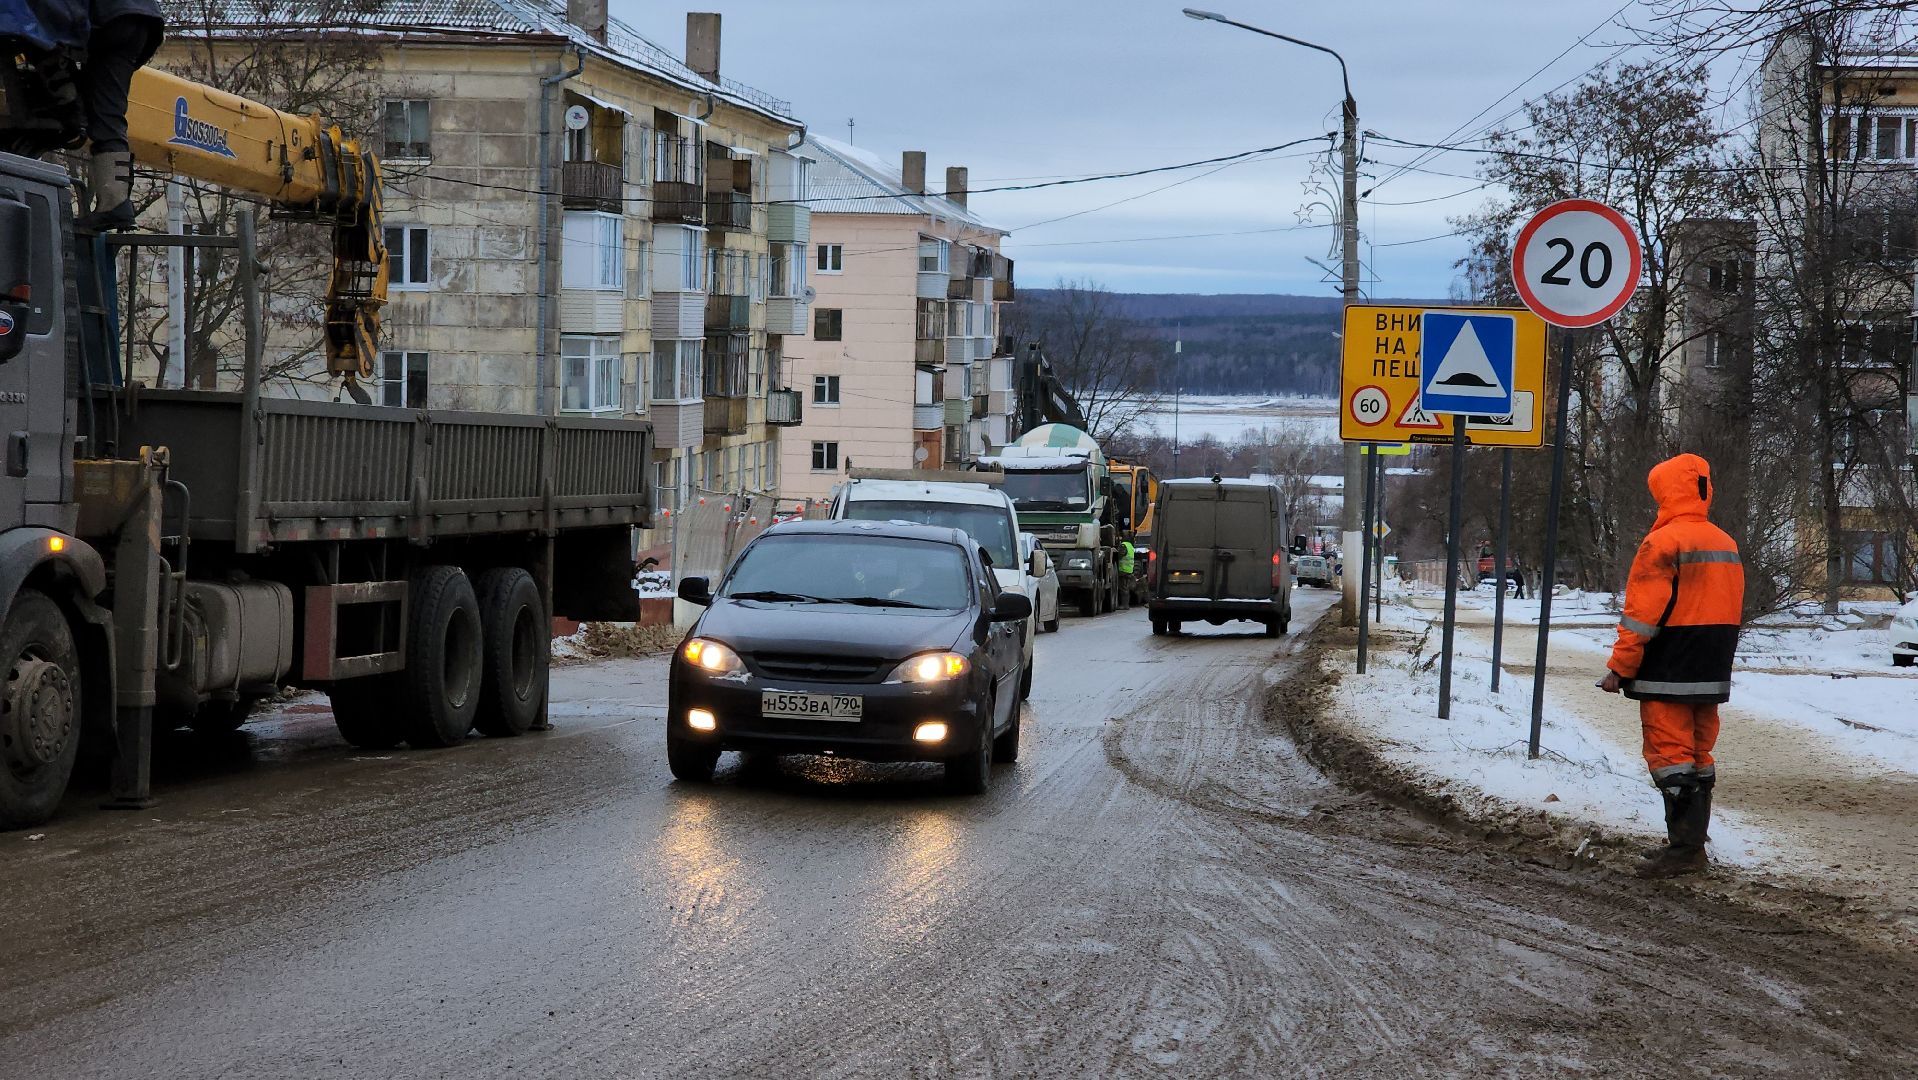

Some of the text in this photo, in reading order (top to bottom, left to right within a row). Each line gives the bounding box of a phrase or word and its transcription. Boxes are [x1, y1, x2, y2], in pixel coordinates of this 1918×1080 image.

[1540, 237, 1612, 289] 20
[1375, 336, 1406, 355] НА
[1360, 398, 1380, 414] 60
[767, 695, 857, 714] Н553ВА 790
